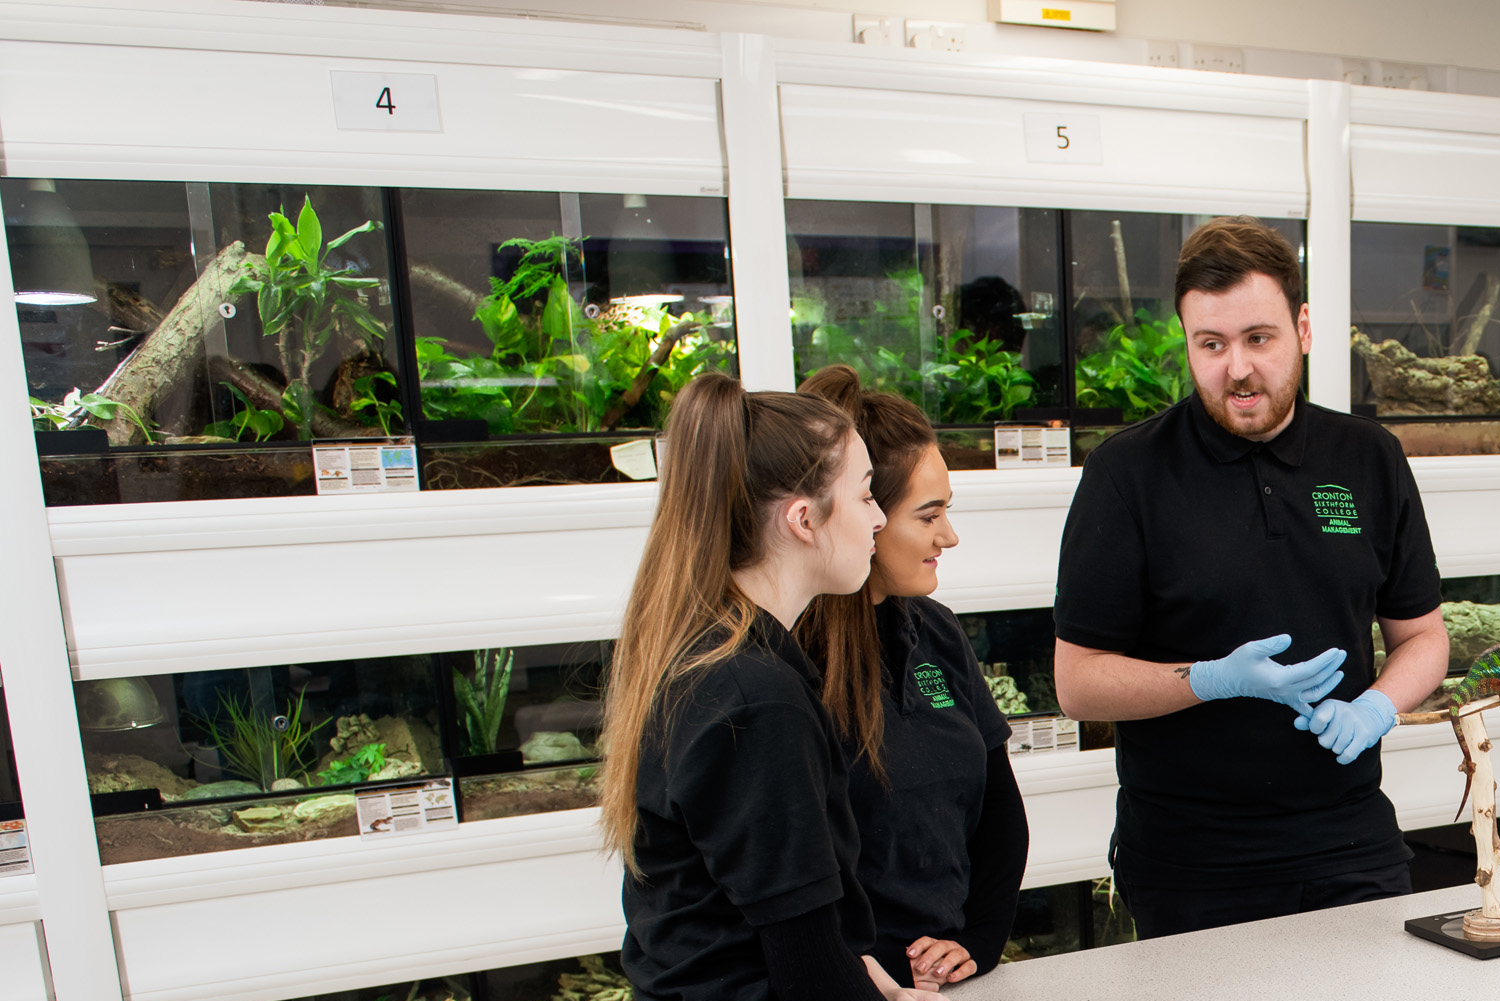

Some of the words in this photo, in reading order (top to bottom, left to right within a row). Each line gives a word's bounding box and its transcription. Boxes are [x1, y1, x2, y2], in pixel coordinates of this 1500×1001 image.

[376, 86, 396, 115] 4
[1057, 125, 1070, 150] 5
[1311, 491, 1353, 501] CRONTON
[1315, 508, 1358, 516] COLLEGE
[1321, 526, 1362, 535] MANAGEMENT
